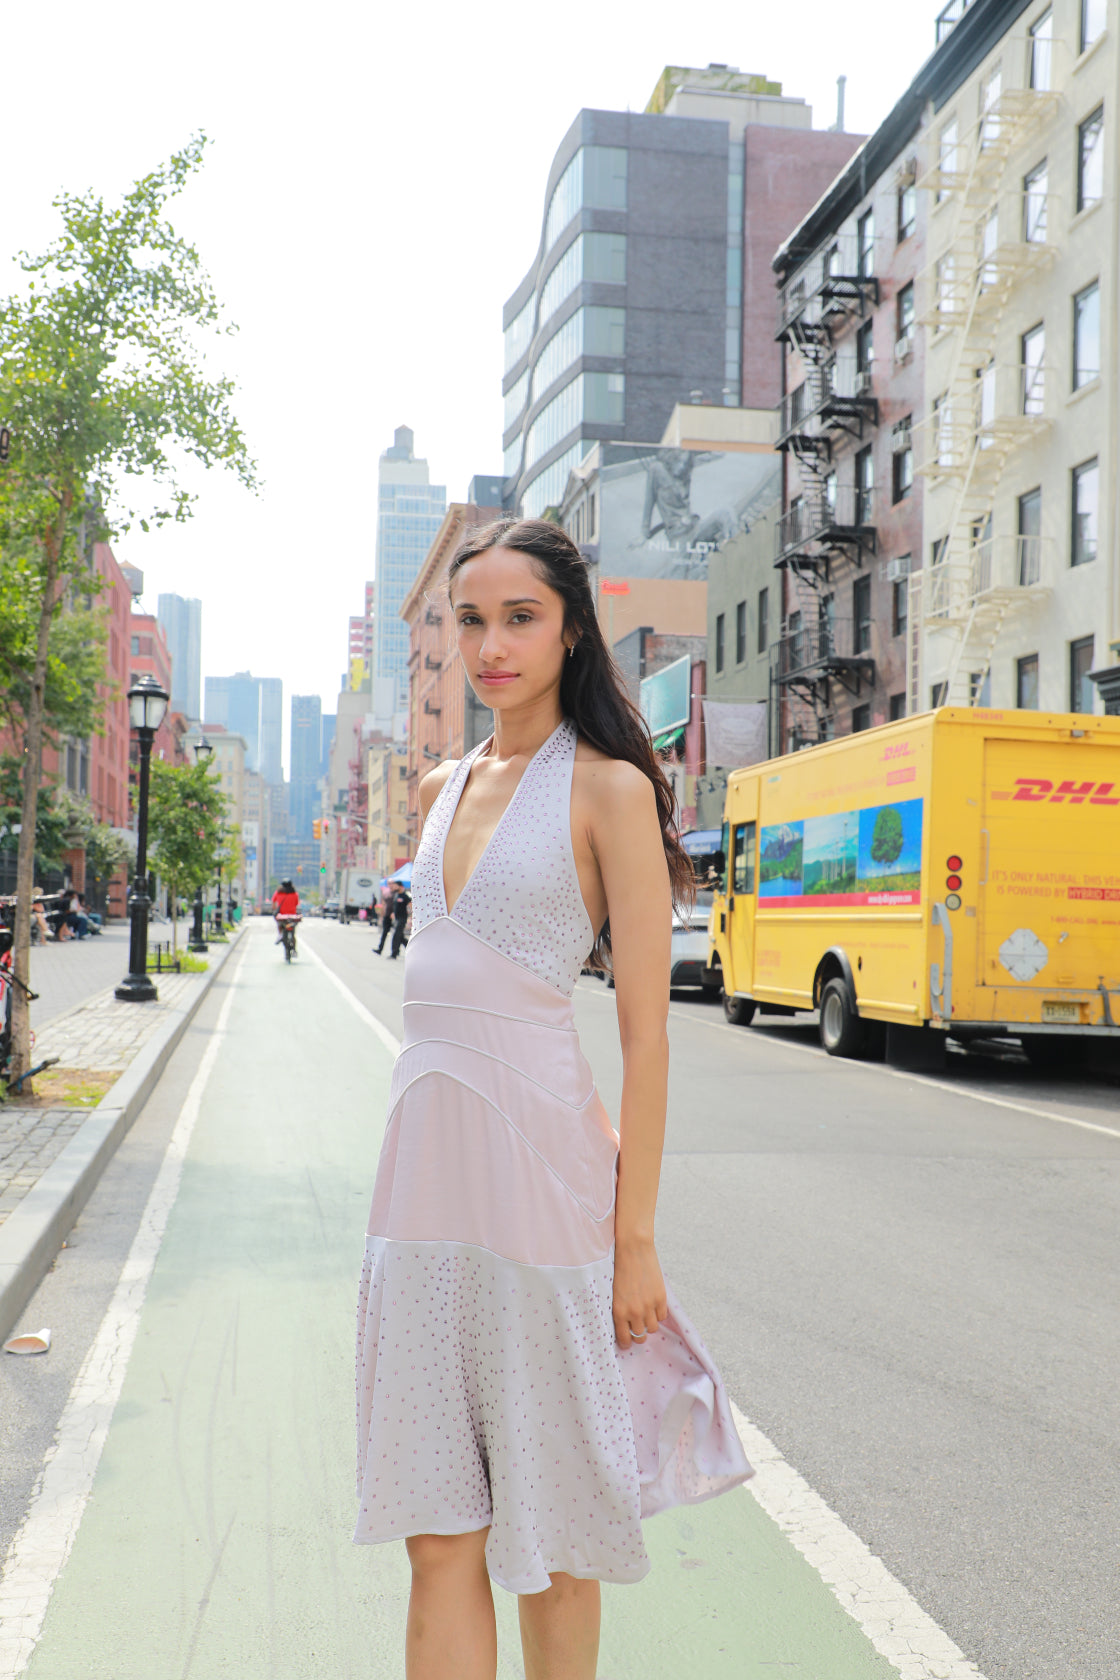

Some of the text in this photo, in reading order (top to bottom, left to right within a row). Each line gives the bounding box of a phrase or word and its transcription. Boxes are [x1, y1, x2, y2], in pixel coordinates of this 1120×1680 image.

[648, 541, 680, 552] NILI
[884, 742, 911, 760] DHL
[1012, 778, 1120, 805] DHL
[992, 870, 1008, 881] IT'S
[1010, 871, 1033, 882] ONLY
[1083, 875, 1102, 886] THIS
[997, 885, 1004, 895] IS
[1007, 885, 1052, 897] POWERED
[1054, 887, 1066, 897] BY
[1069, 888, 1103, 899] HYBRID
